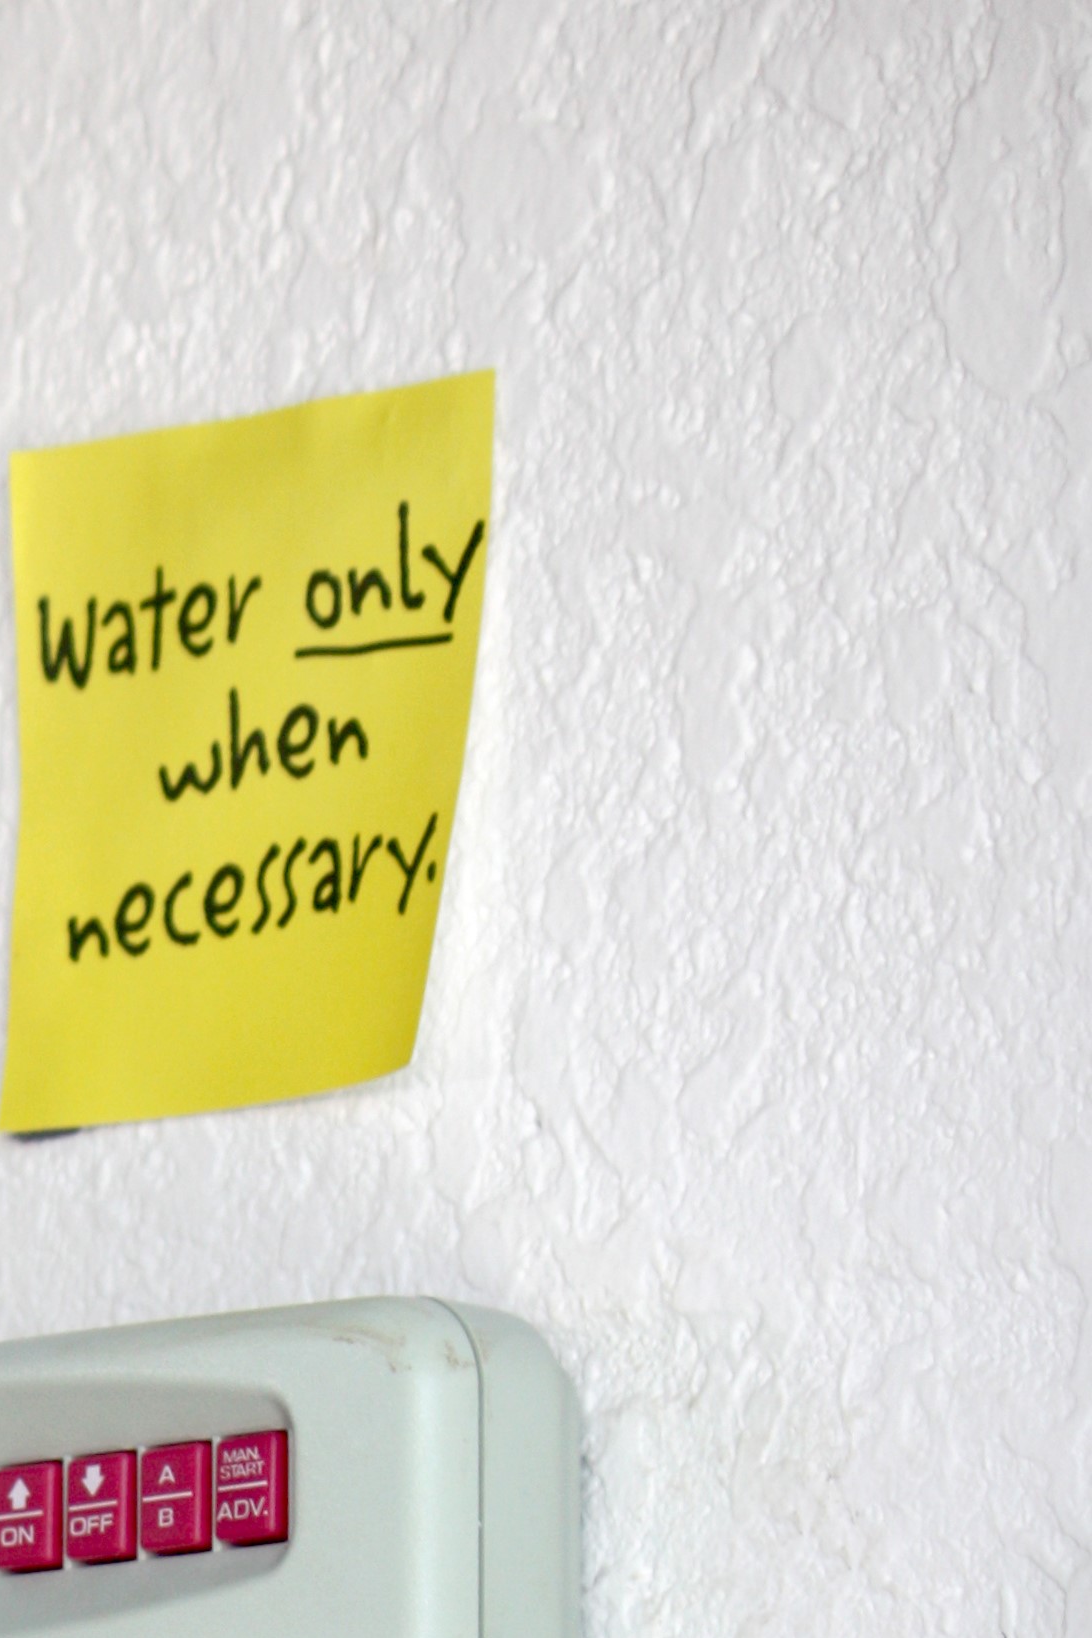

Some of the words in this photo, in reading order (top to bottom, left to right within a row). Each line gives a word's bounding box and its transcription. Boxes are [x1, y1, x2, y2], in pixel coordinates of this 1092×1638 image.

[39, 566, 262, 691] Water
[305, 500, 485, 629] only
[159, 687, 369, 801] when
[67, 812, 438, 962] necessary.
[158, 1465, 176, 1485] A
[219, 1460, 264, 1480] START
[158, 1508, 175, 1528] B
[216, 1497, 269, 1522] ADV.
[0, 1525, 35, 1547] ON
[69, 1513, 114, 1536] OFF
